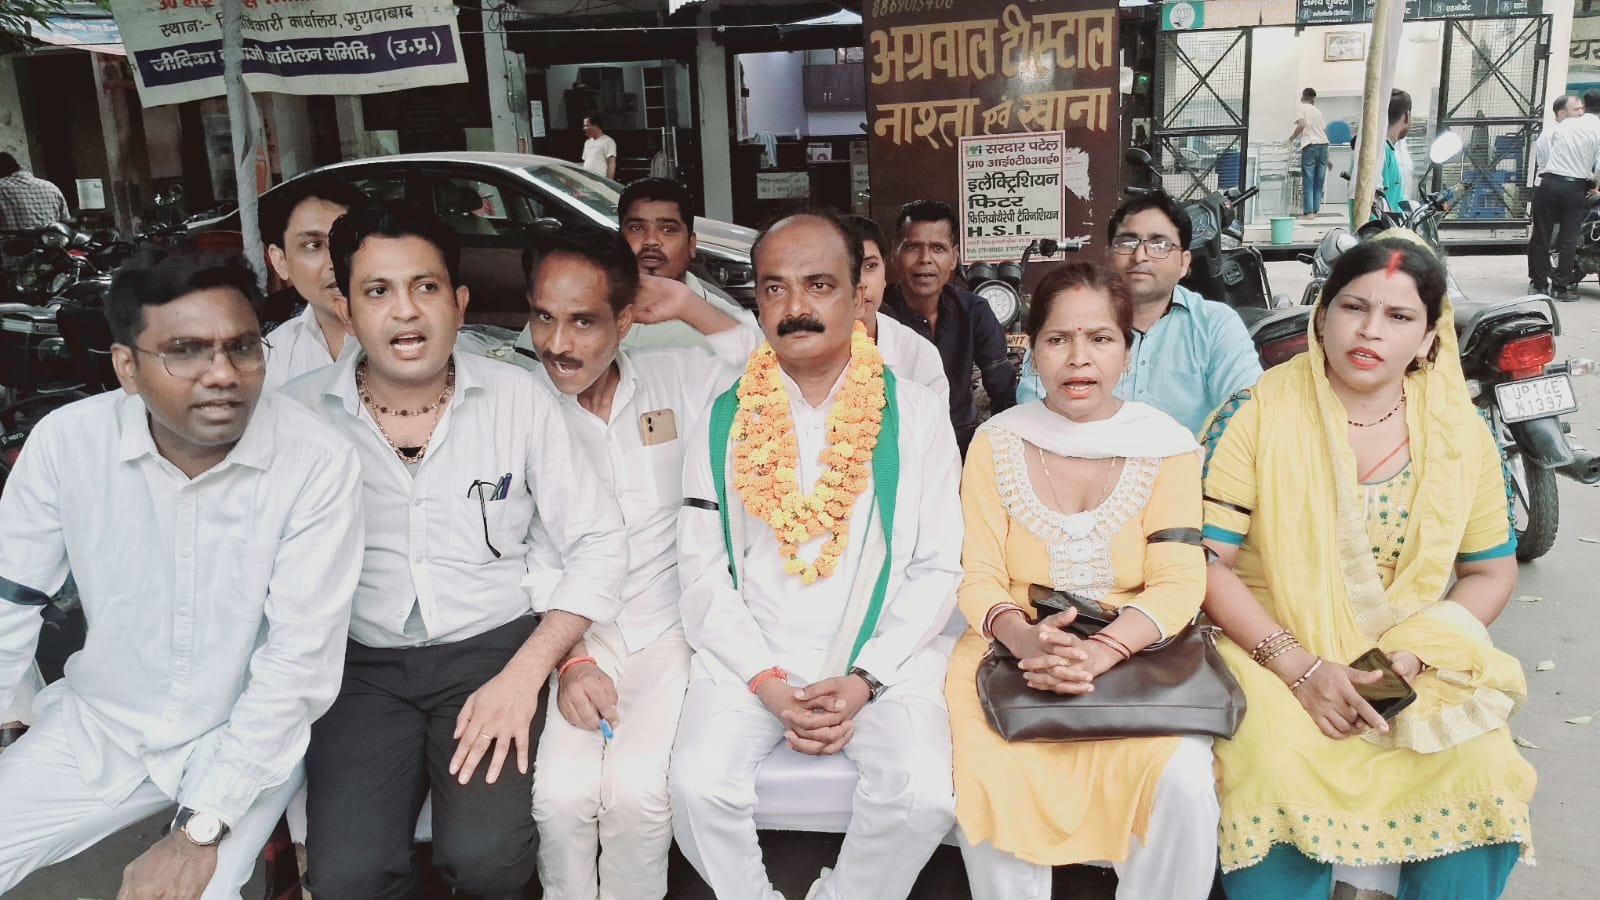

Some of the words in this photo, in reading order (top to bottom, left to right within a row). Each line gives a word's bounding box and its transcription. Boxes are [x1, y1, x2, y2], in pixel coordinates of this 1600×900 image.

[344, 5, 414, 31] मुरादाबाद
[265, 45, 323, 65] आंदोलन
[324, 40, 376, 62] समिति,
[387, 31, 441, 61] (उ.प्र.)
[869, 19, 999, 85] अग्रवाल
[874, 98, 980, 149] नाश्ता
[982, 96, 1013, 135] एवं
[1018, 88, 1111, 133] खाना
[985, 142, 1026, 155] सरदार
[1029, 138, 1060, 151] पटेल
[967, 194, 1025, 209] फिटर
